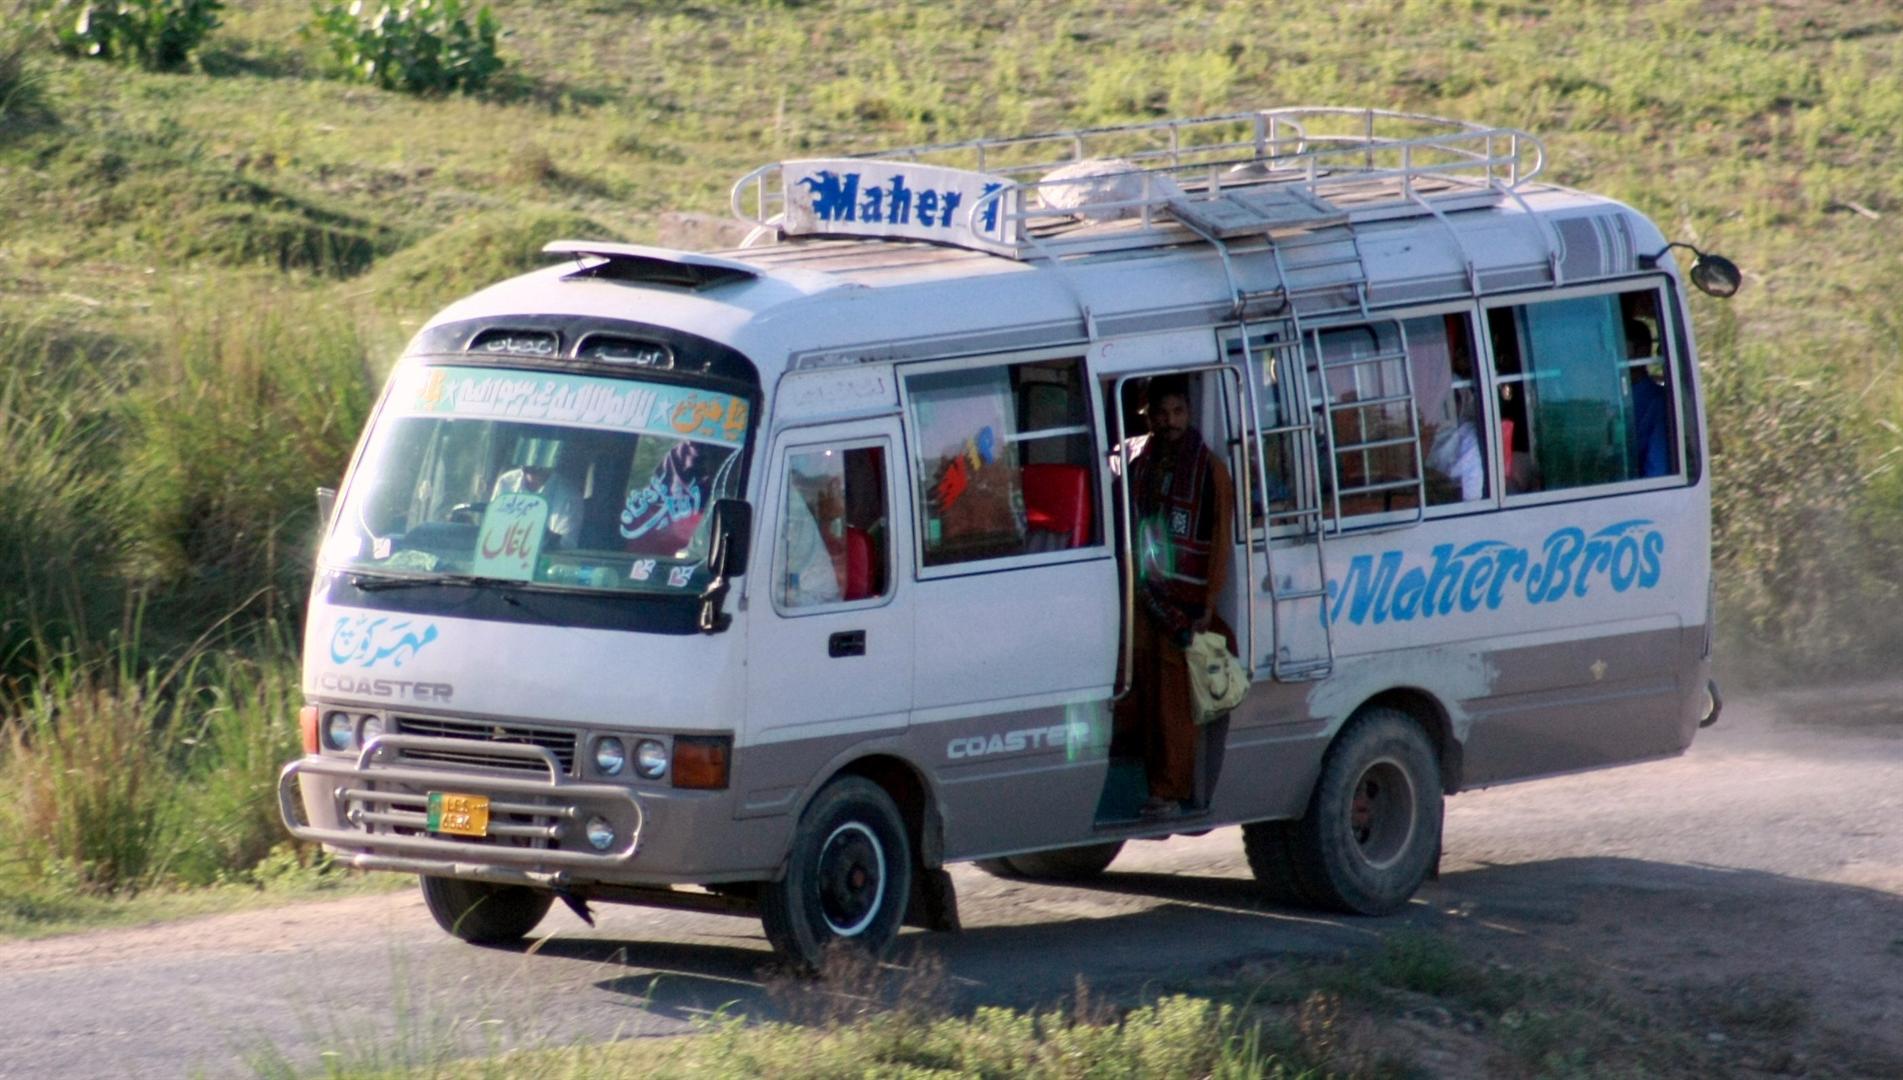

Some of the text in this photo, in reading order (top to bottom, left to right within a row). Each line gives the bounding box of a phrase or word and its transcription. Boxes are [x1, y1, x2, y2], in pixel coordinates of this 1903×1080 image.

[797, 170, 962, 228] Maher
[1319, 519, 1664, 629] Maher Bros
[321, 672, 453, 703] COASTER
[946, 721, 1090, 759] COASTER
